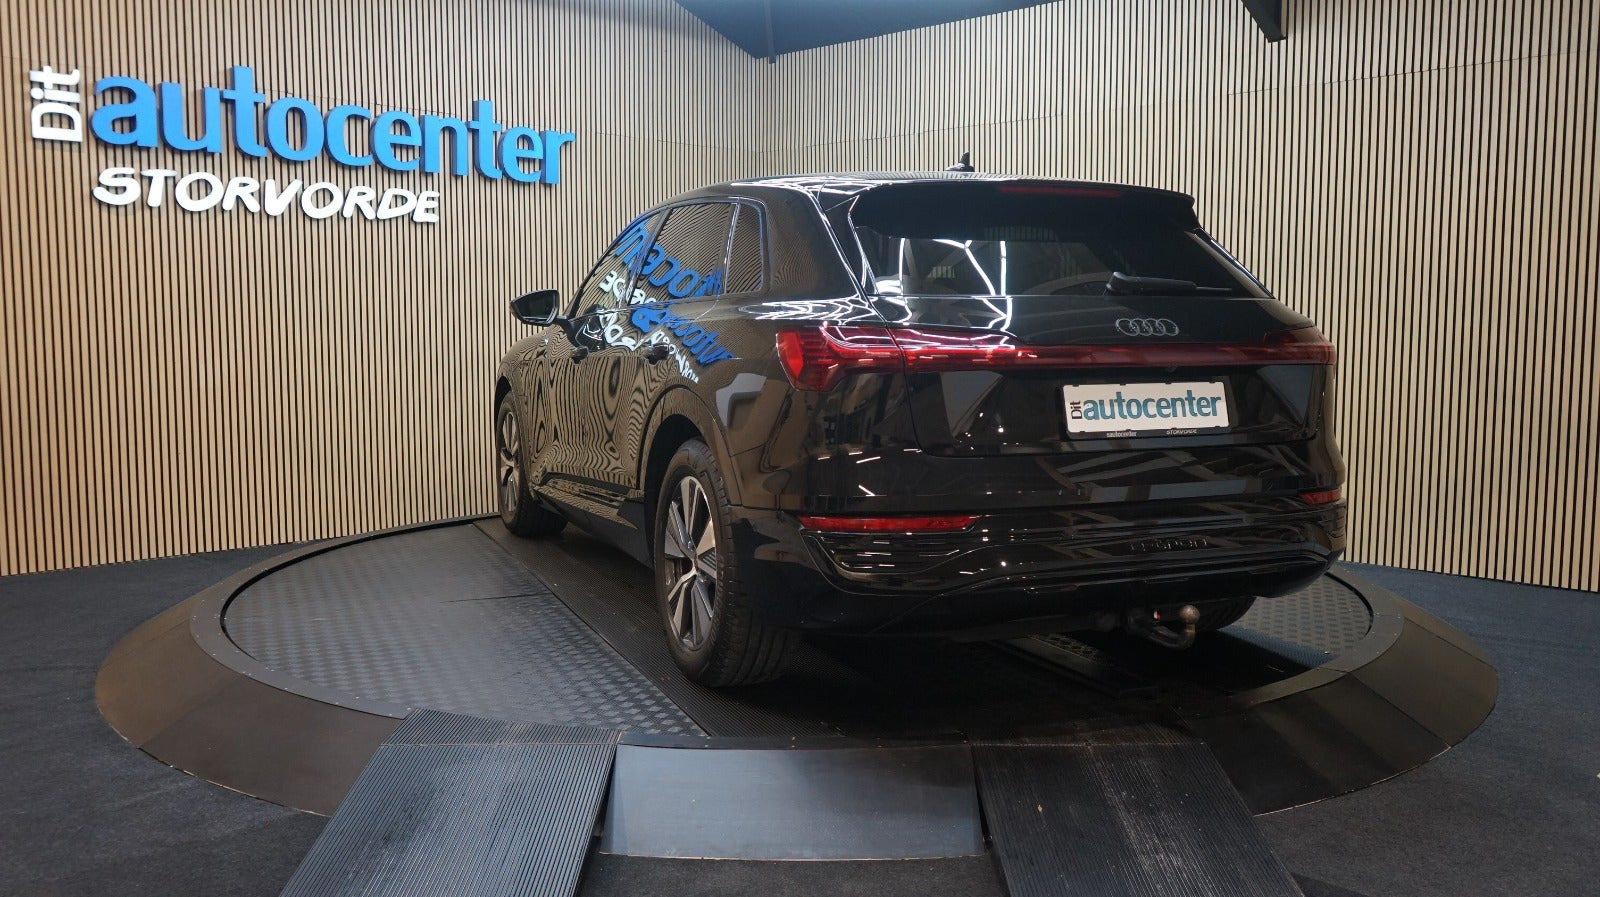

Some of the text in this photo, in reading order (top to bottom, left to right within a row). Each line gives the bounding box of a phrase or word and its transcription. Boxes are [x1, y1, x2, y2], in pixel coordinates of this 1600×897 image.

[29, 65, 576, 185] Dit autocenter
[93, 167, 440, 223] STORVORDE
[1070, 390, 1221, 420] Dit autocenter
